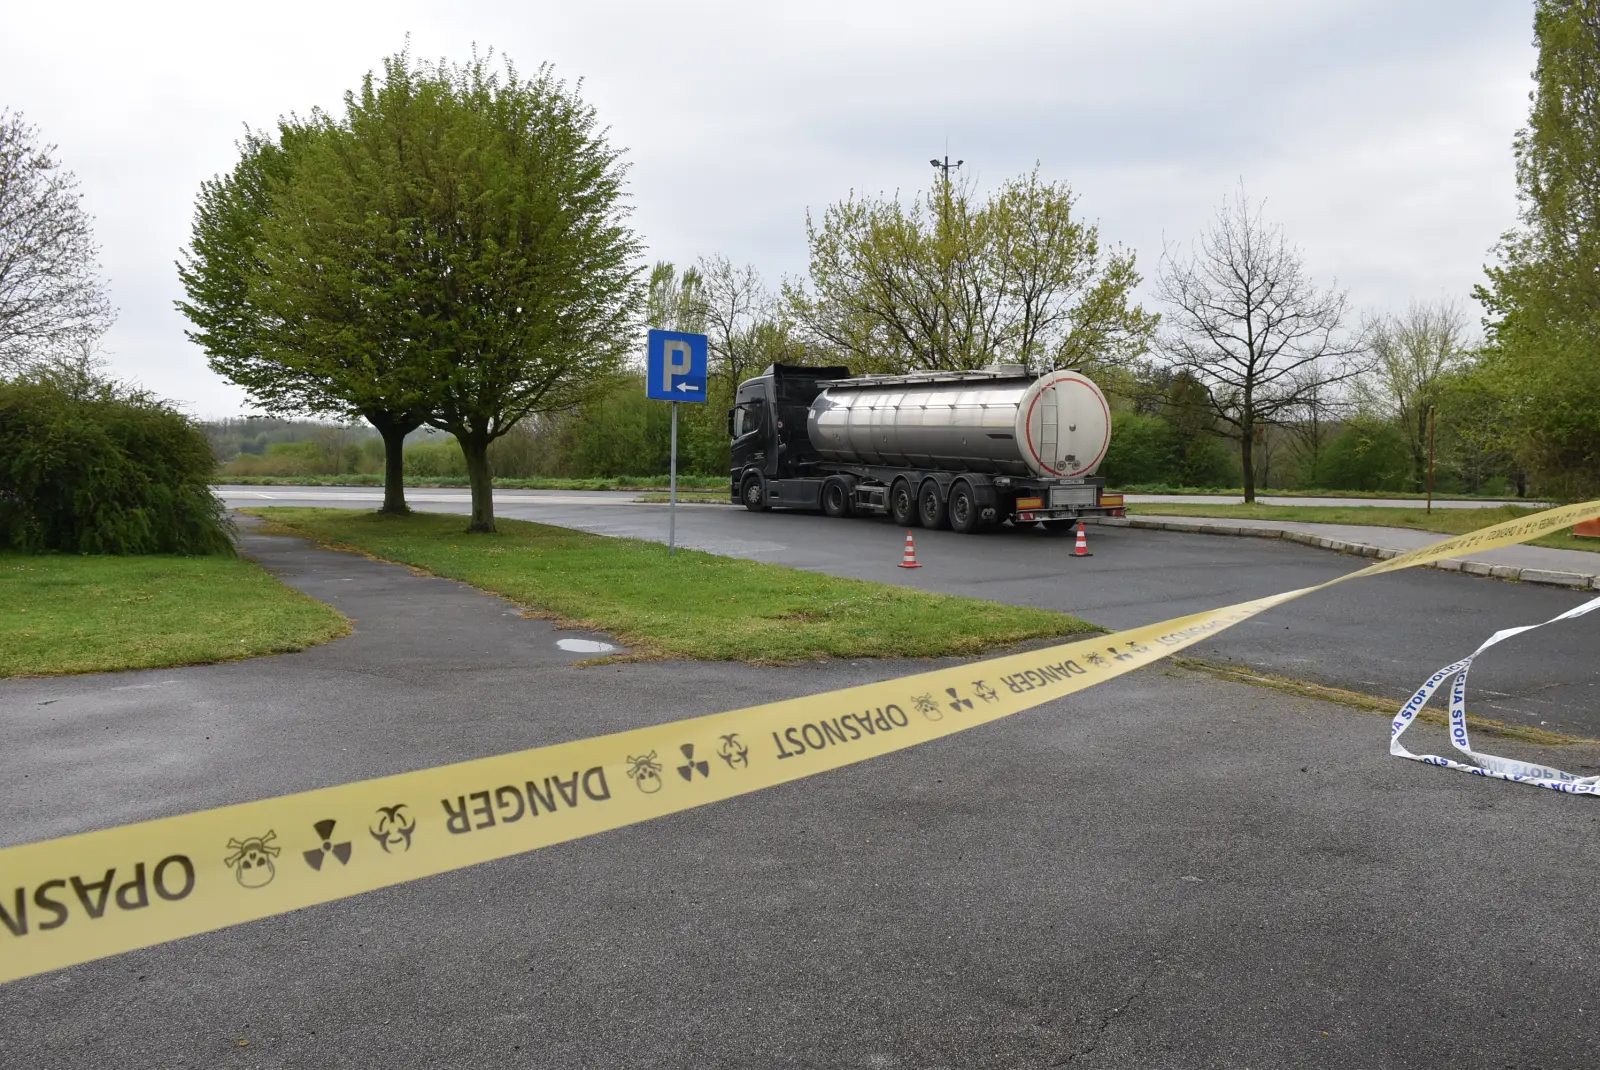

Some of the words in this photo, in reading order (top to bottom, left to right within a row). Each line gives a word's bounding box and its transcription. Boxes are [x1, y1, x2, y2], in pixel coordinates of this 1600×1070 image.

[663, 340, 692, 392] P
[1000, 660, 1087, 693] DANGER
[1401, 689, 1427, 720] STOP
[772, 704, 908, 759] OPASNOST
[1452, 709, 1467, 746] STOP
[441, 766, 611, 834] DANGER
